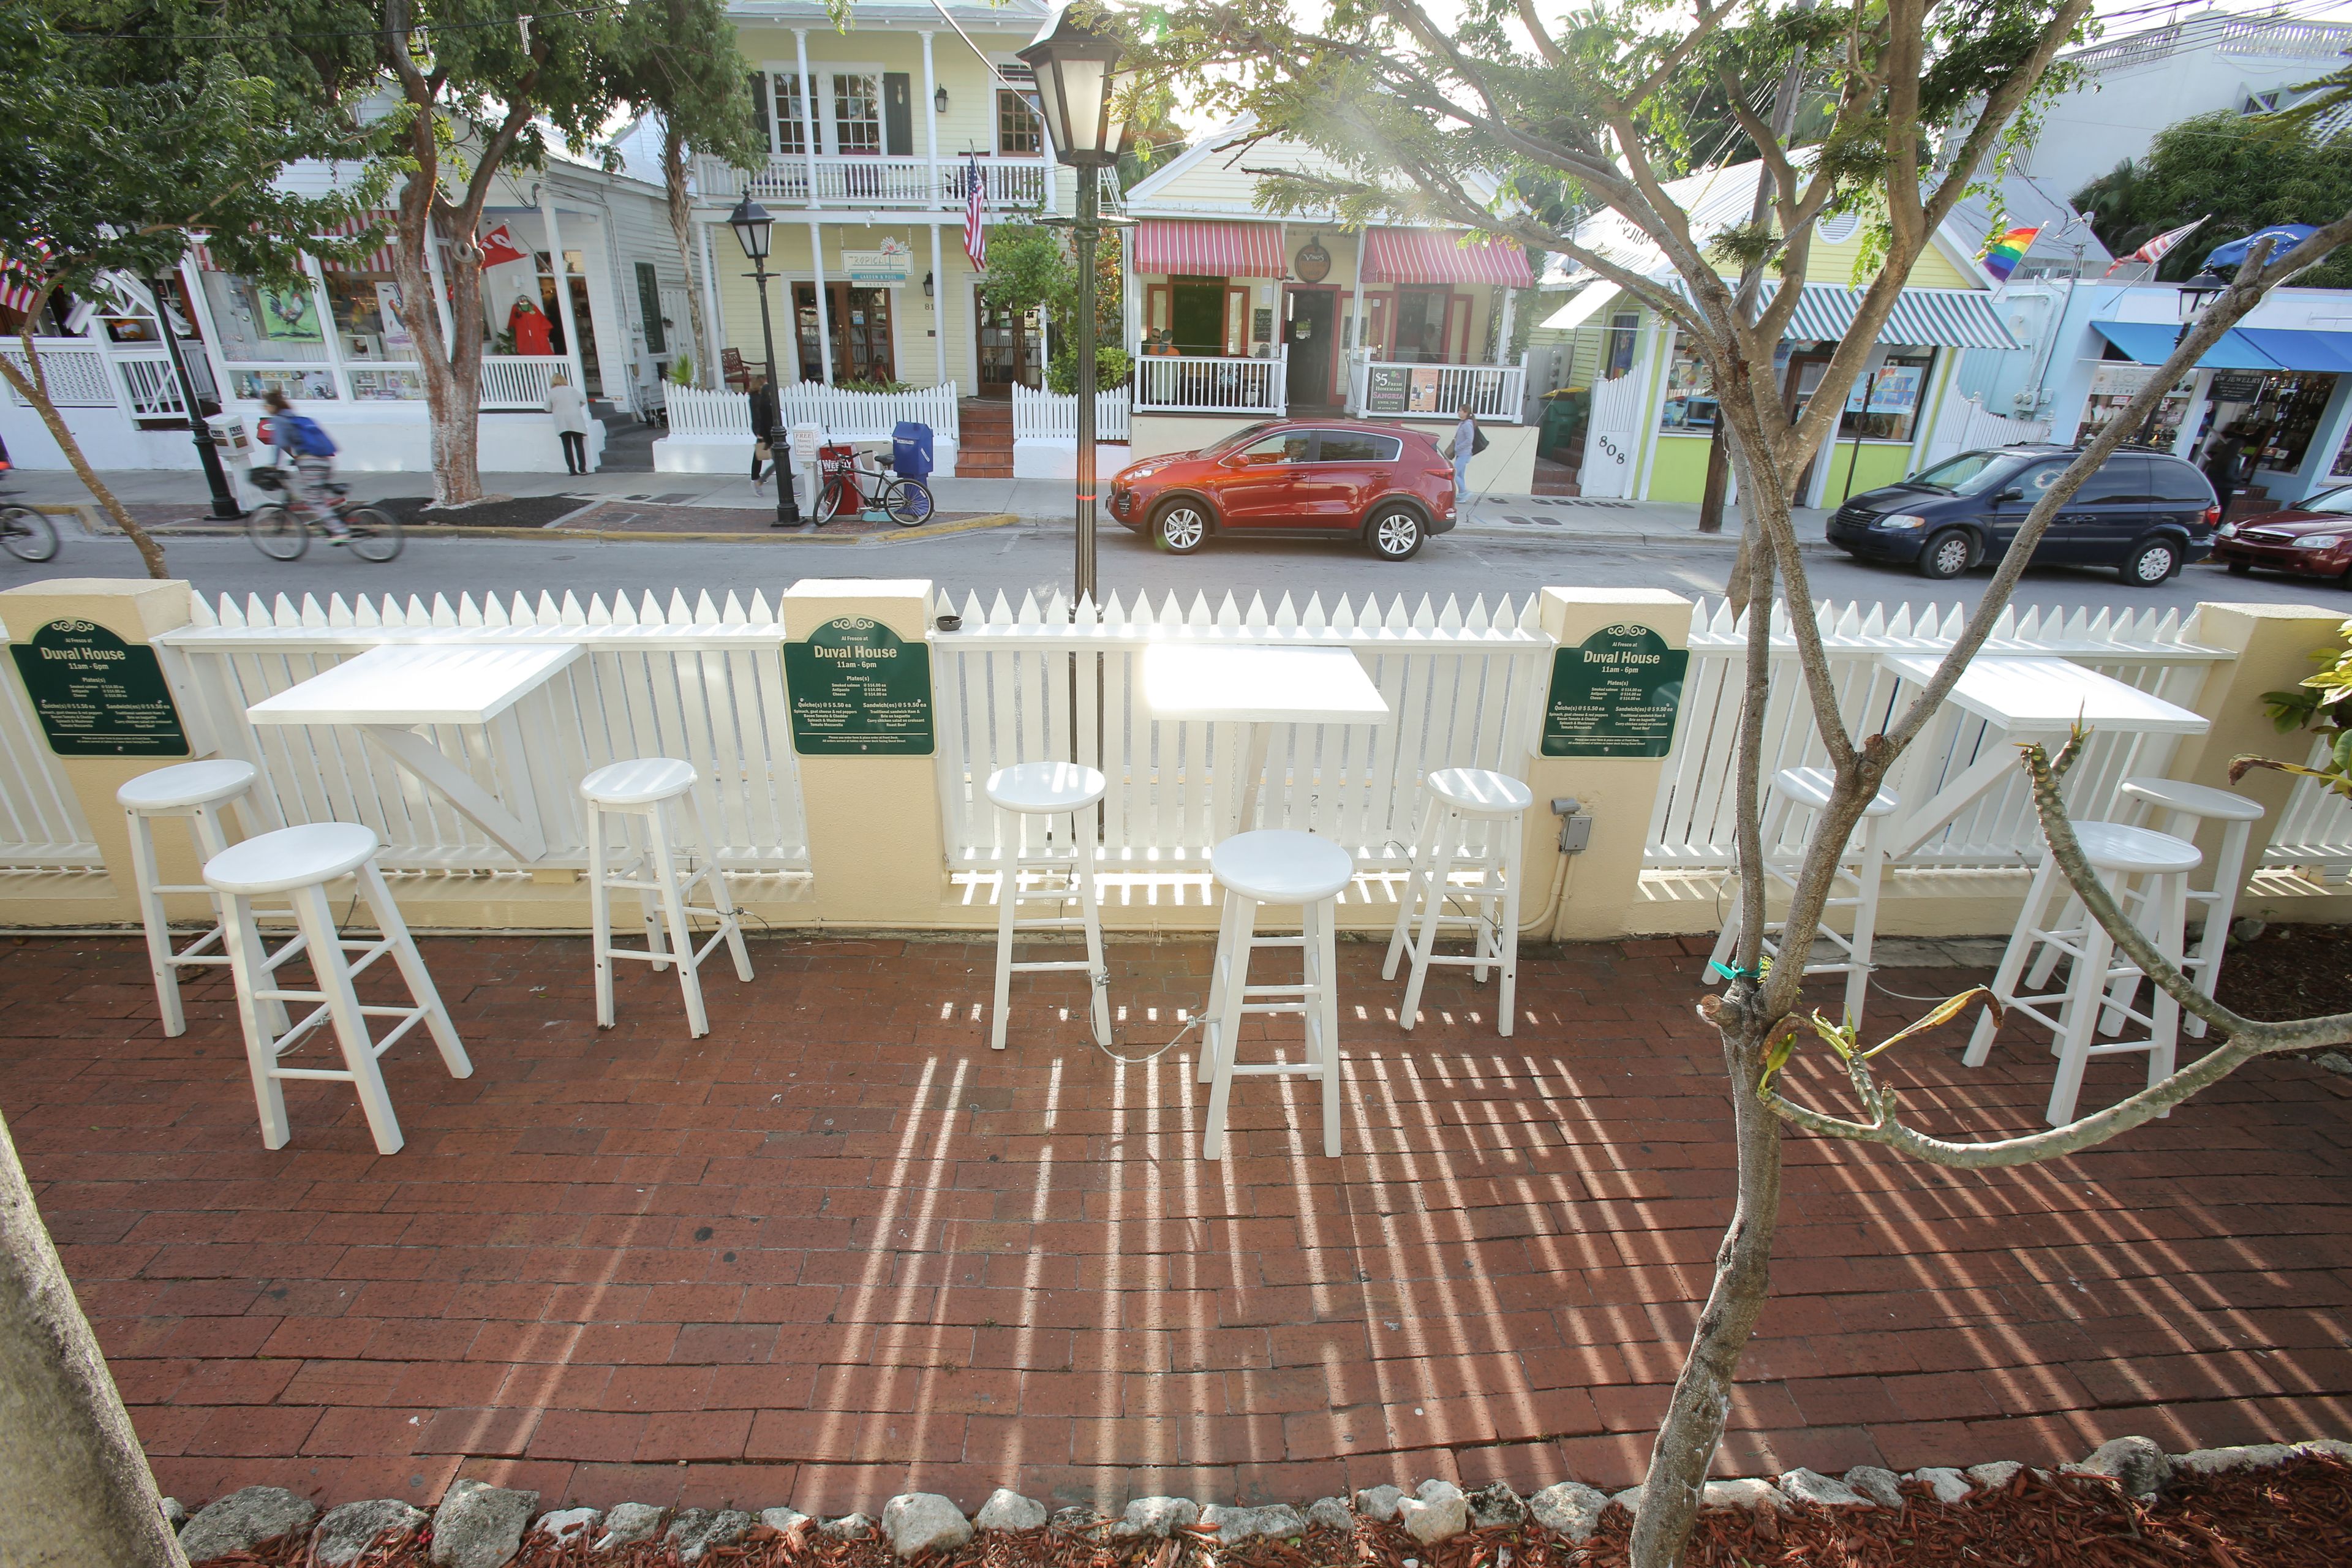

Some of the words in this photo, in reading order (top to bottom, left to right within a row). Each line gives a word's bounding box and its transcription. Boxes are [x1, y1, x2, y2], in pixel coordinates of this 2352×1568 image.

[848, 256, 889, 265] TROPICAL
[1375, 372, 1387, 386] $5
[1599, 435, 1624, 464] 808
[42, 647, 80, 660] Duval
[82, 647, 125, 660] House
[814, 646, 851, 658] Duval
[854, 645, 897, 658] House
[1583, 650, 1619, 663] Duval
[1621, 650, 1660, 664] House
